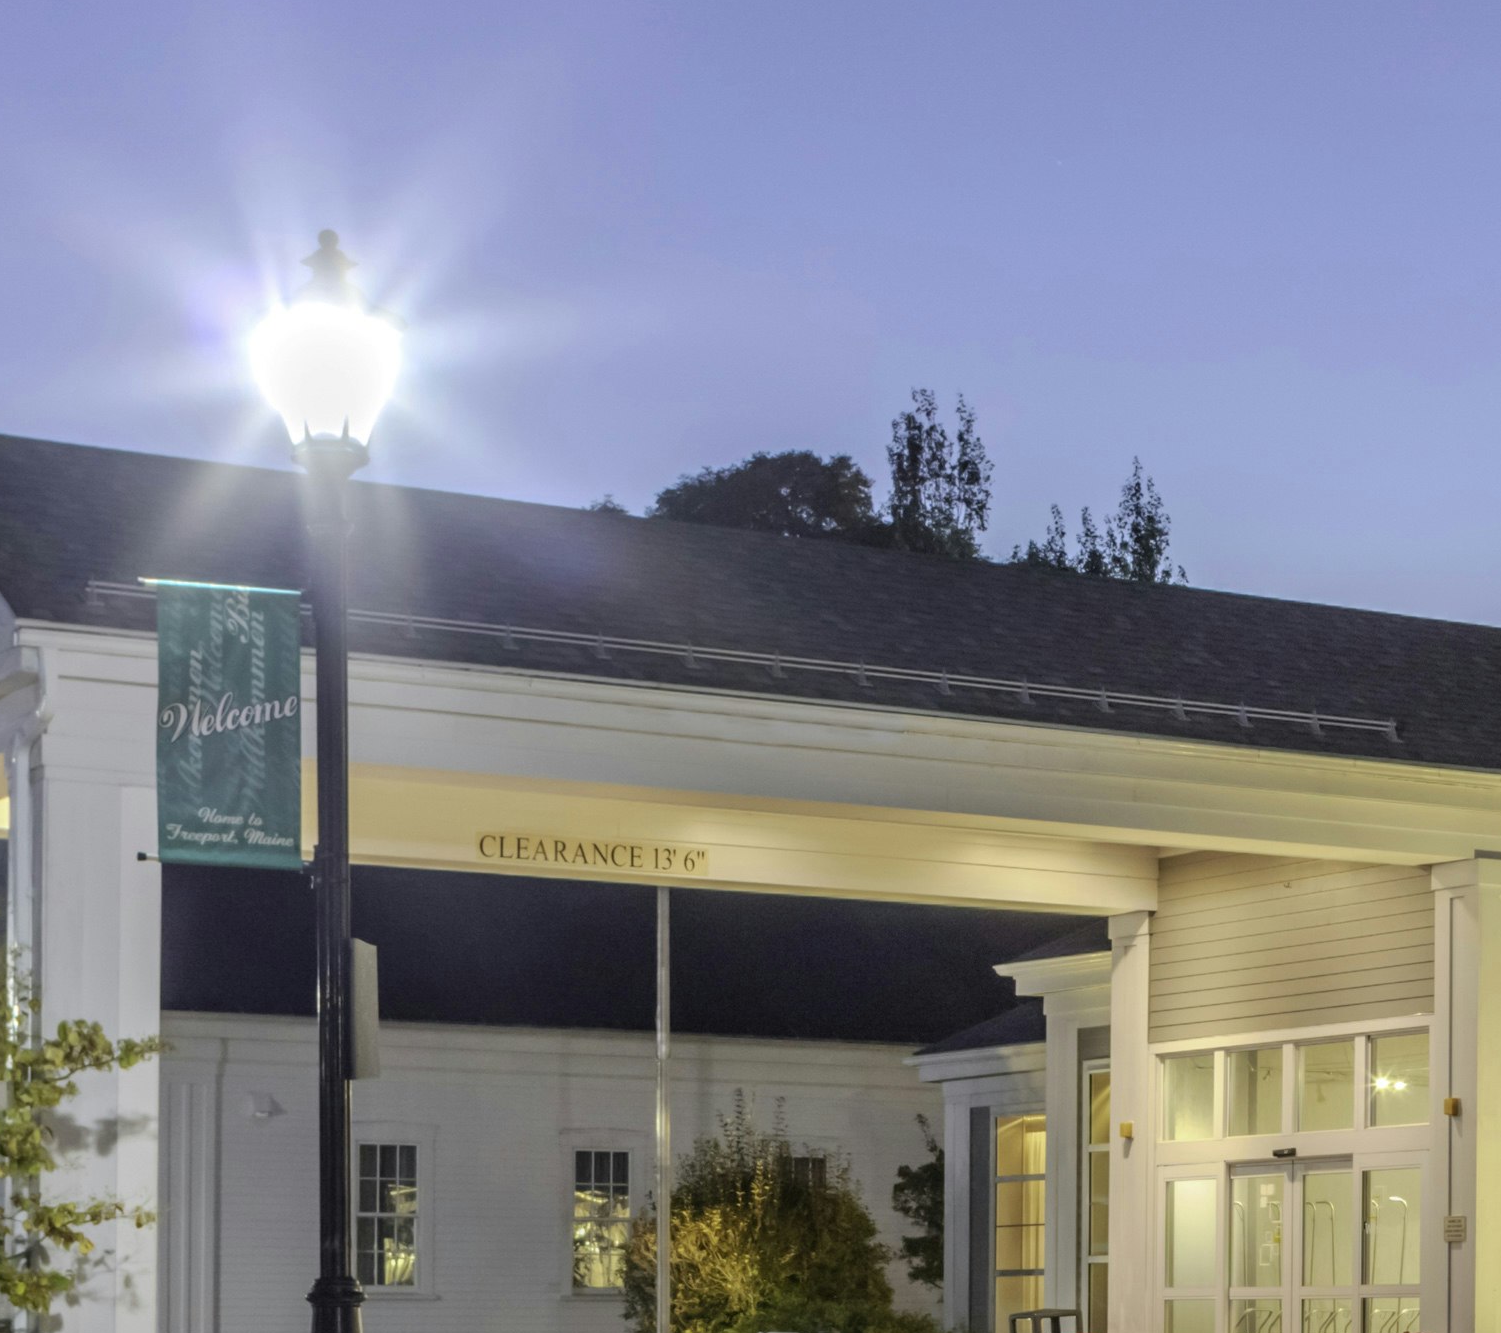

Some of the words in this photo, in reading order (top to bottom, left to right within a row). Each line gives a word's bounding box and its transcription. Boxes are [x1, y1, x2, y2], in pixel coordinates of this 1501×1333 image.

[159, 691, 298, 743] Welcome
[197, 806, 244, 825] Home
[248, 812, 263, 826] to
[166, 823, 238, 845] Freeport,
[244, 828, 294, 846] Maine
[479, 834, 644, 868] CLEARANCE
